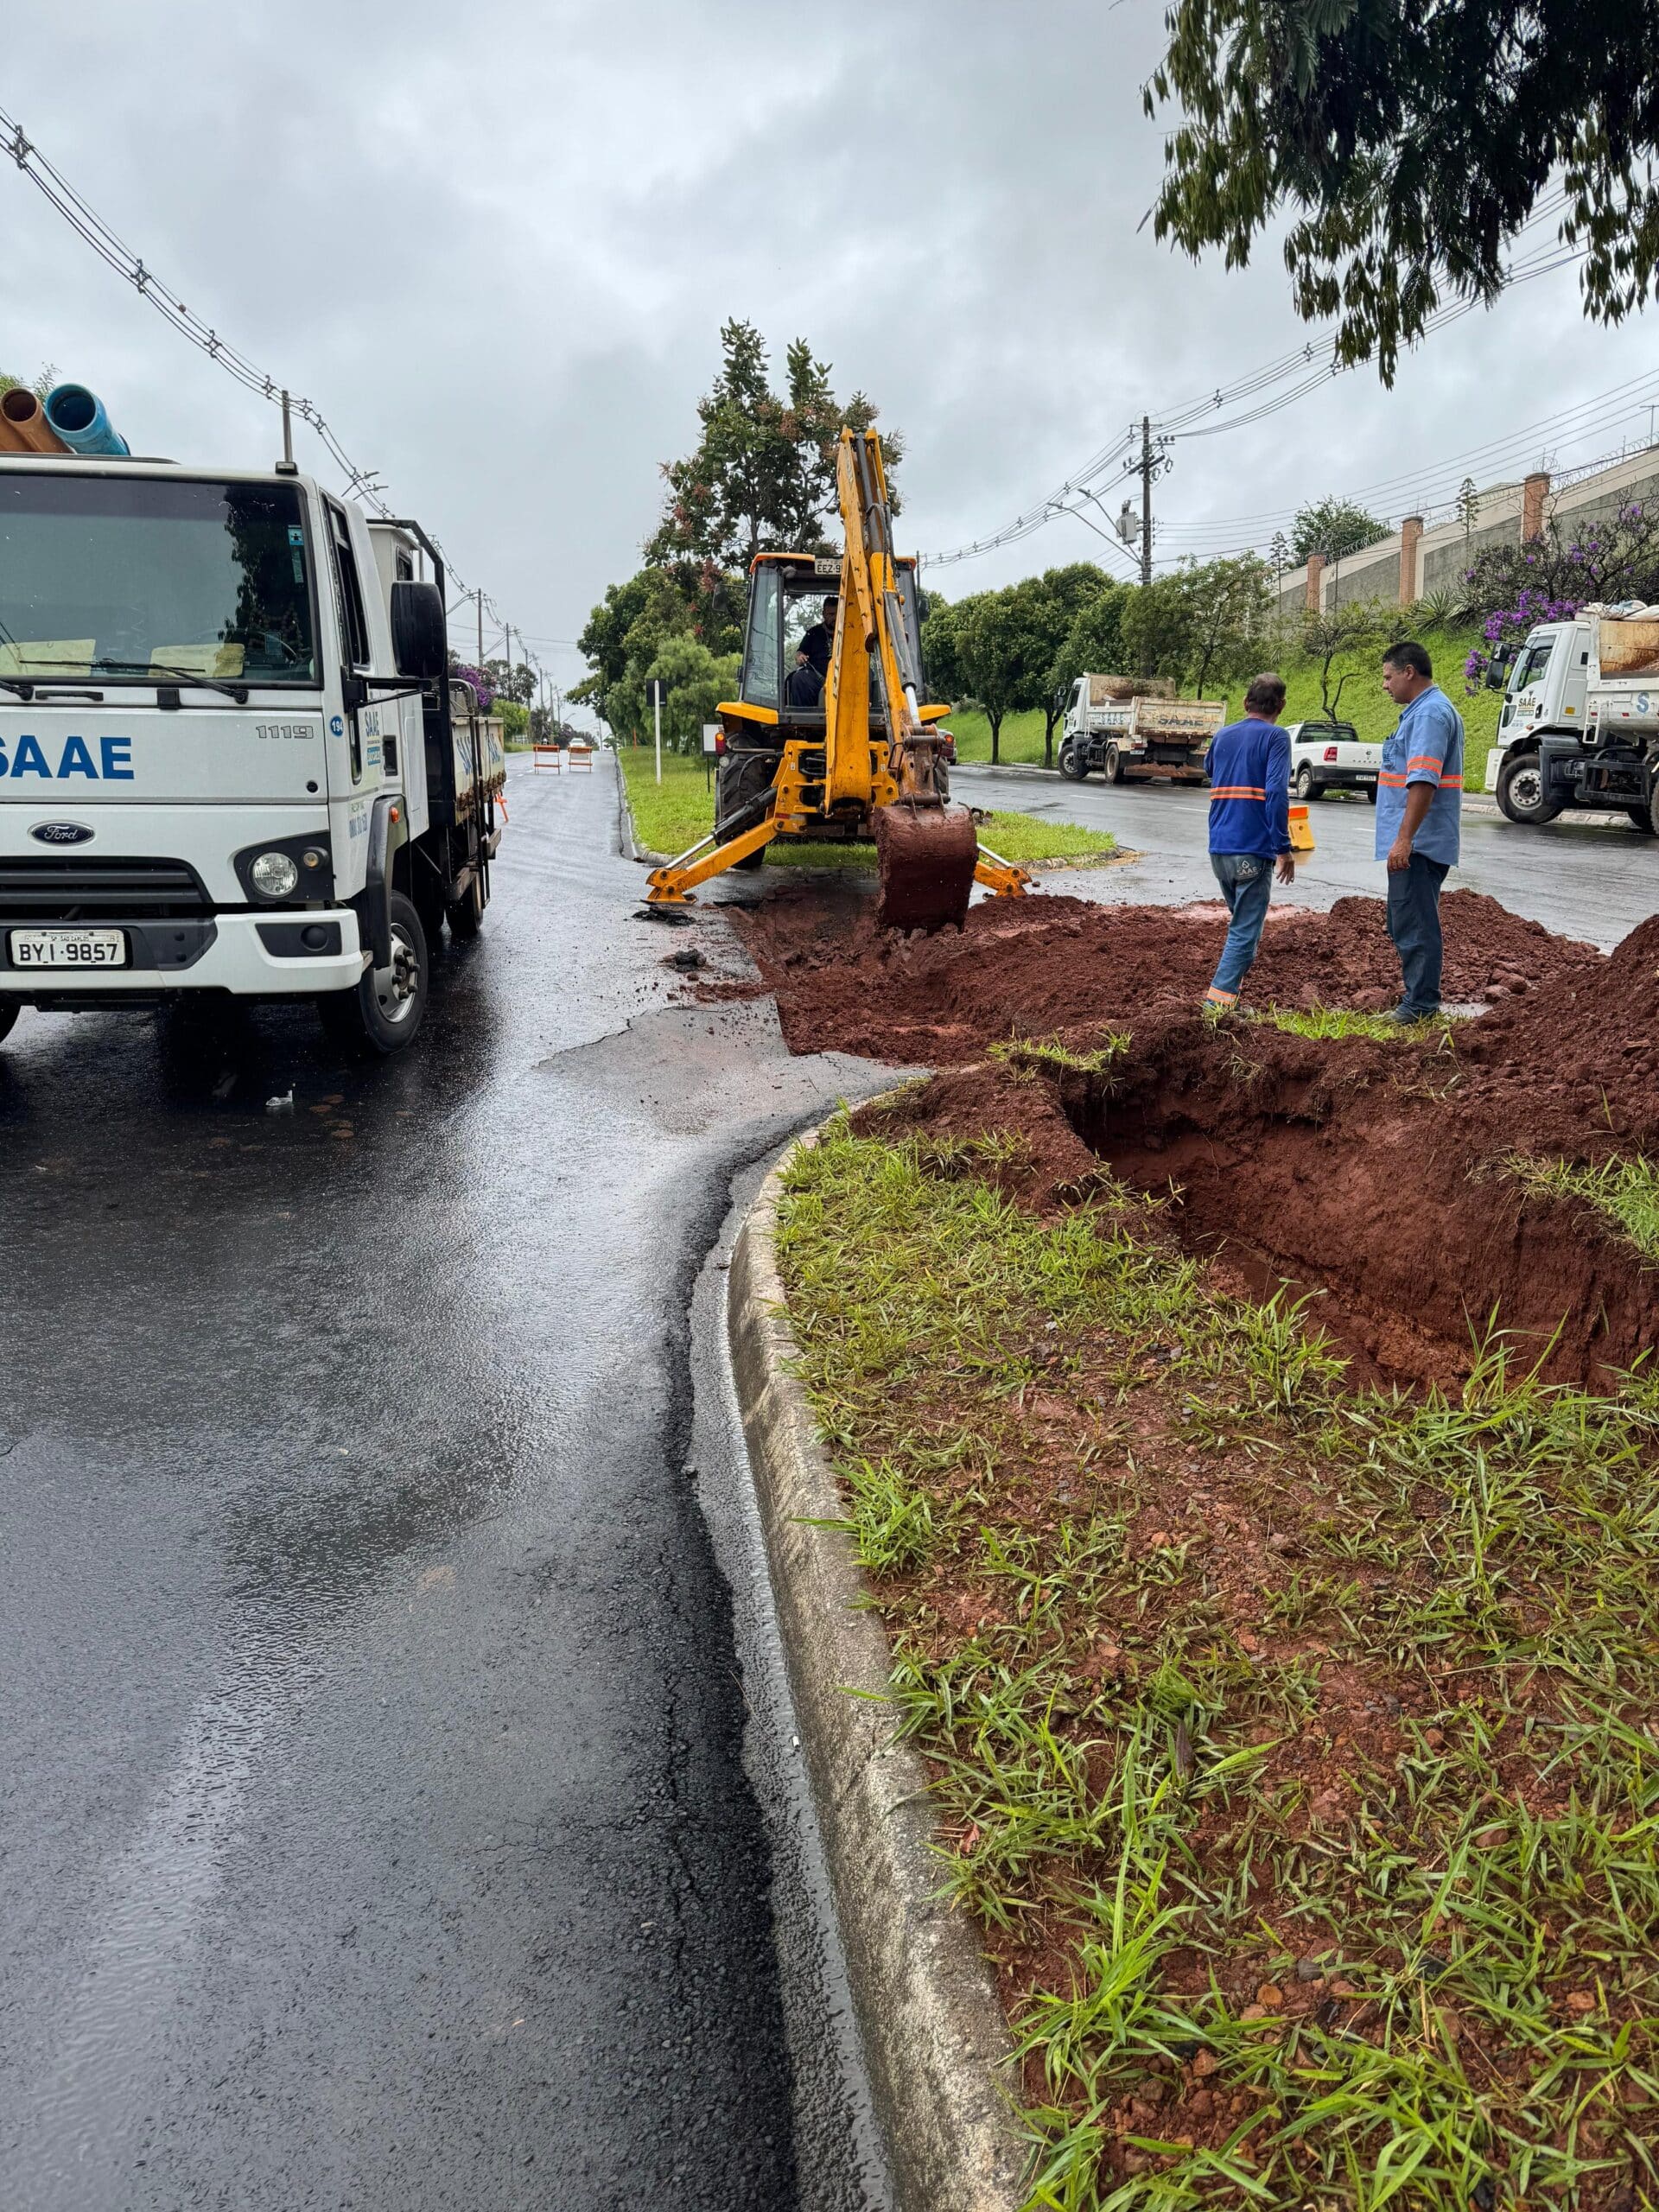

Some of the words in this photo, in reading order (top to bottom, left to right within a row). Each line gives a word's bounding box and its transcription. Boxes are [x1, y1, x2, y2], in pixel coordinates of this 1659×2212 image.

[1518, 697, 1536, 707] SAAE
[256, 725, 314, 739] 1119
[0, 735, 135, 779] AAE
[44, 825, 78, 840] Ford
